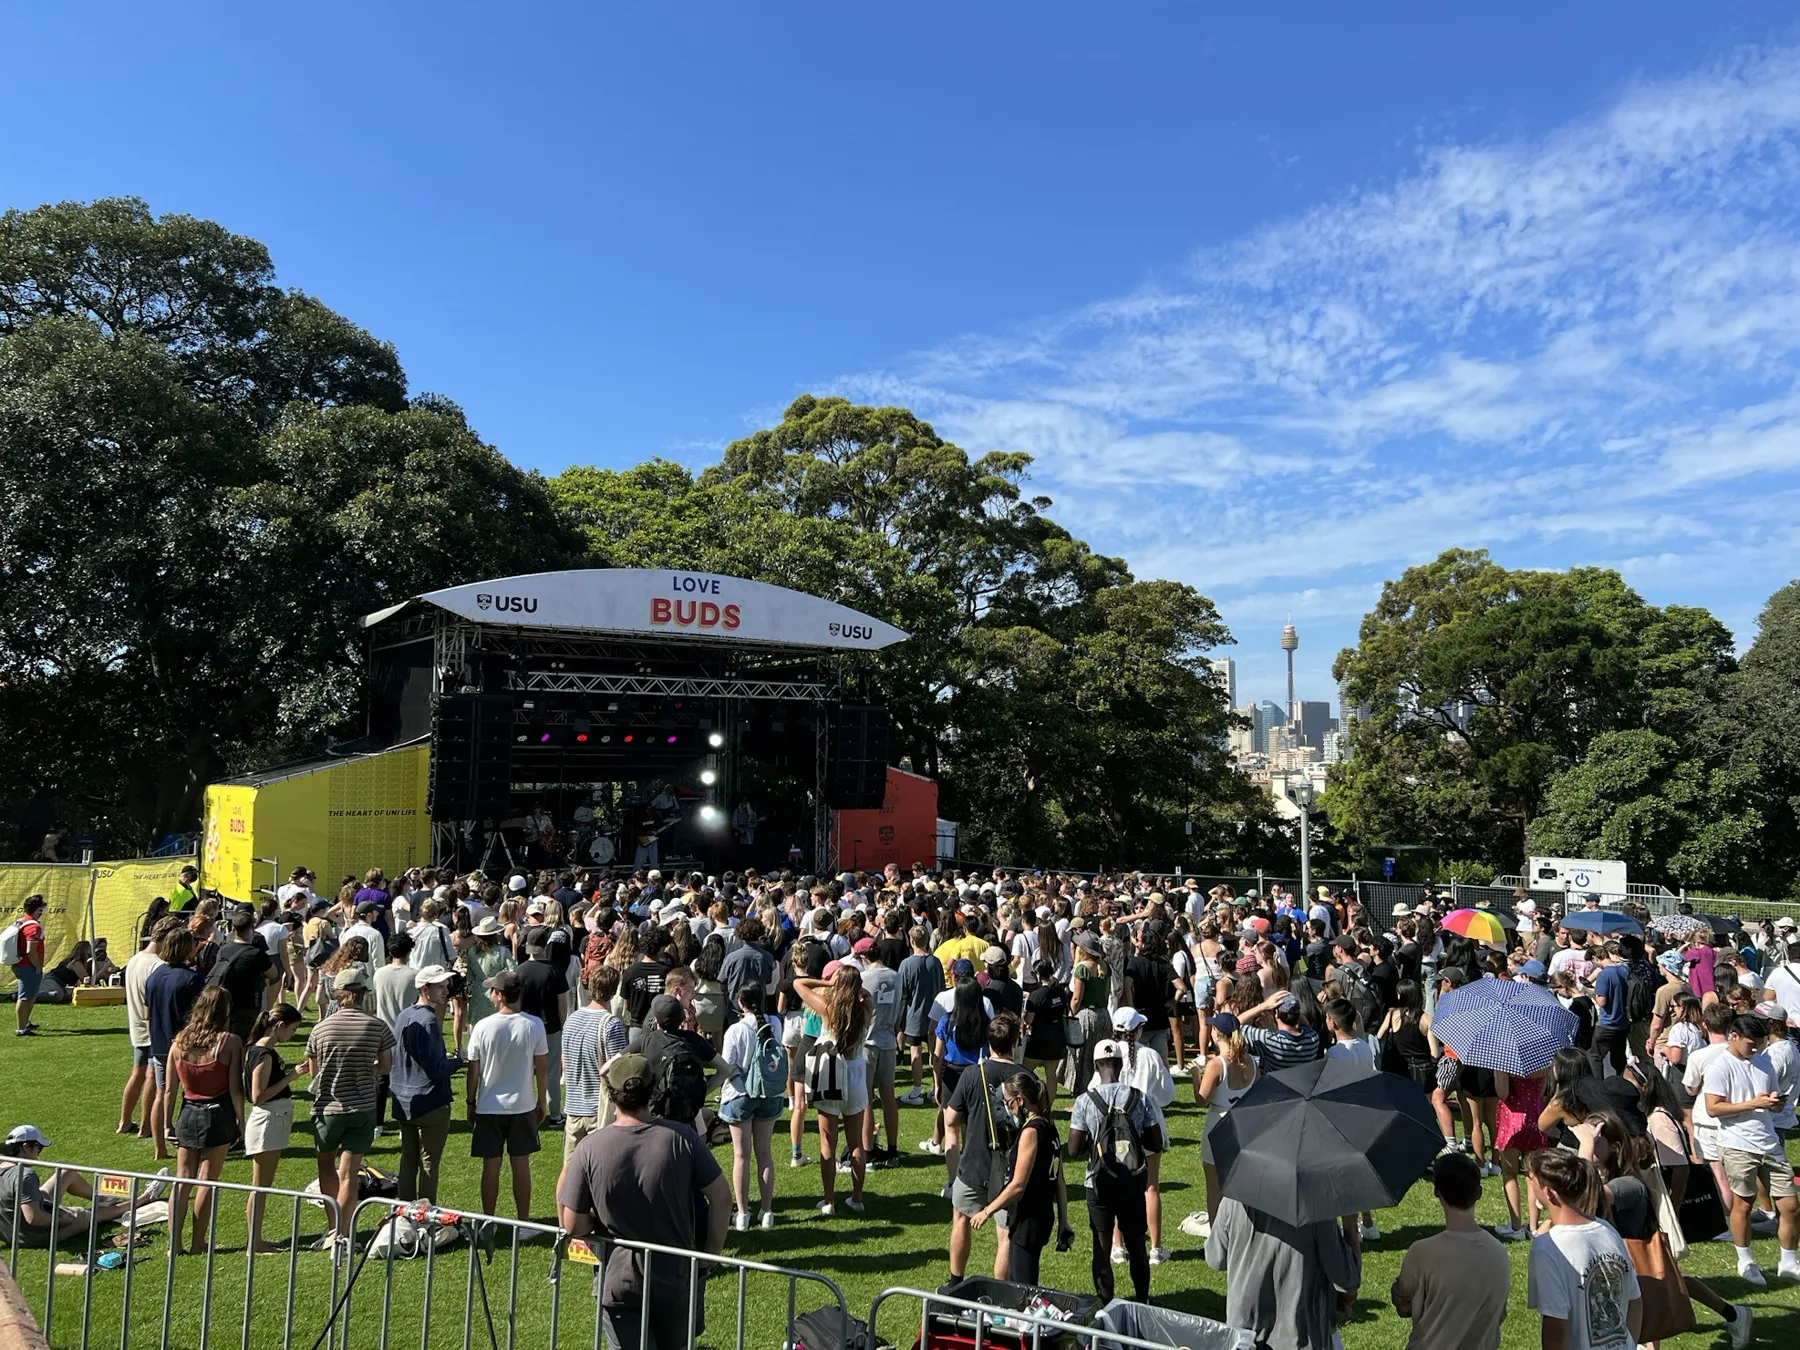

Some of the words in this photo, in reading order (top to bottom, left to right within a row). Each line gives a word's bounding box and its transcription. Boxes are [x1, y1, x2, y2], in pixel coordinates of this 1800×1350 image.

[673, 576, 720, 594] LOVE
[495, 596, 537, 613] USU
[651, 597, 741, 629] BUDS
[842, 624, 873, 639] USU
[230, 819, 244, 833] BUDS
[871, 852, 900, 861] SYDNEY
[104, 1177, 127, 1191] TFH
